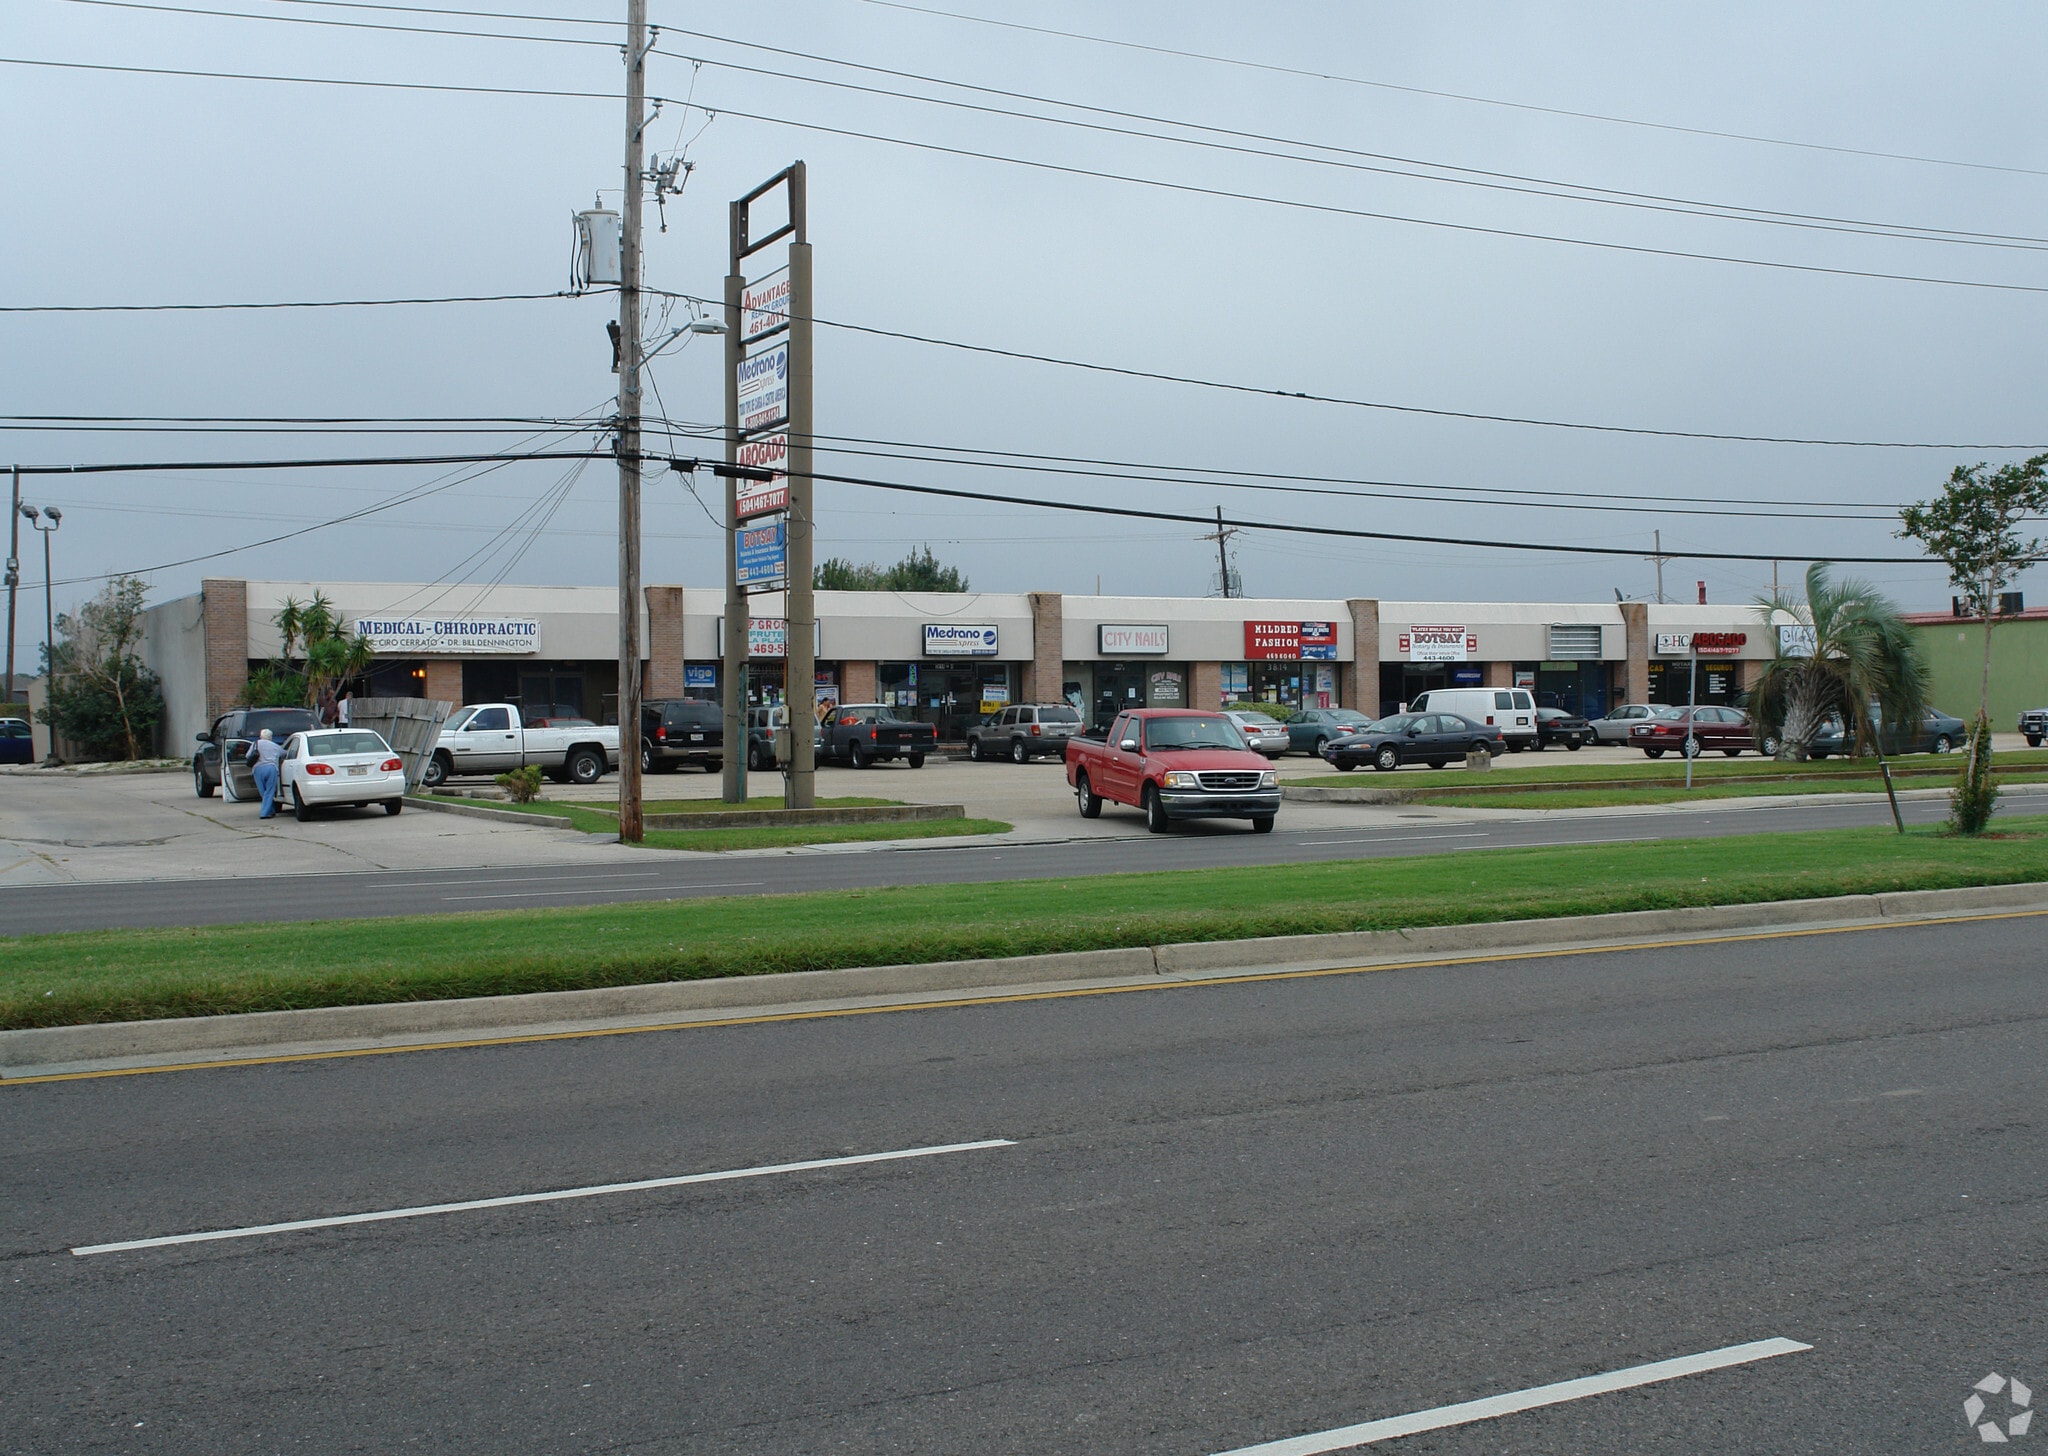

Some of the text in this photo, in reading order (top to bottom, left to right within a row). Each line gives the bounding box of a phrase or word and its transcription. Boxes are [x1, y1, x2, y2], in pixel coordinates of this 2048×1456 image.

[744, 280, 790, 313] ADVANTAGE
[749, 308, 784, 335] 461-4011
[739, 355, 775, 383] Medrano
[740, 435, 785, 466] ABOGADO
[744, 527, 777, 548] BOTSAY
[359, 621, 424, 635] MEDICAL
[434, 621, 536, 636] CHIROPRACTIC
[749, 630, 784, 638] FRUTE
[927, 626, 980, 638] Medrano
[1255, 625, 1298, 634] MILDRED
[1104, 632, 1166, 646] CITY NAILS
[1255, 638, 1298, 647] FASHION
[1414, 634, 1462, 643] BOTSAY
[1693, 633, 1747, 646] ABOGADO
[687, 667, 712, 679] vigo
